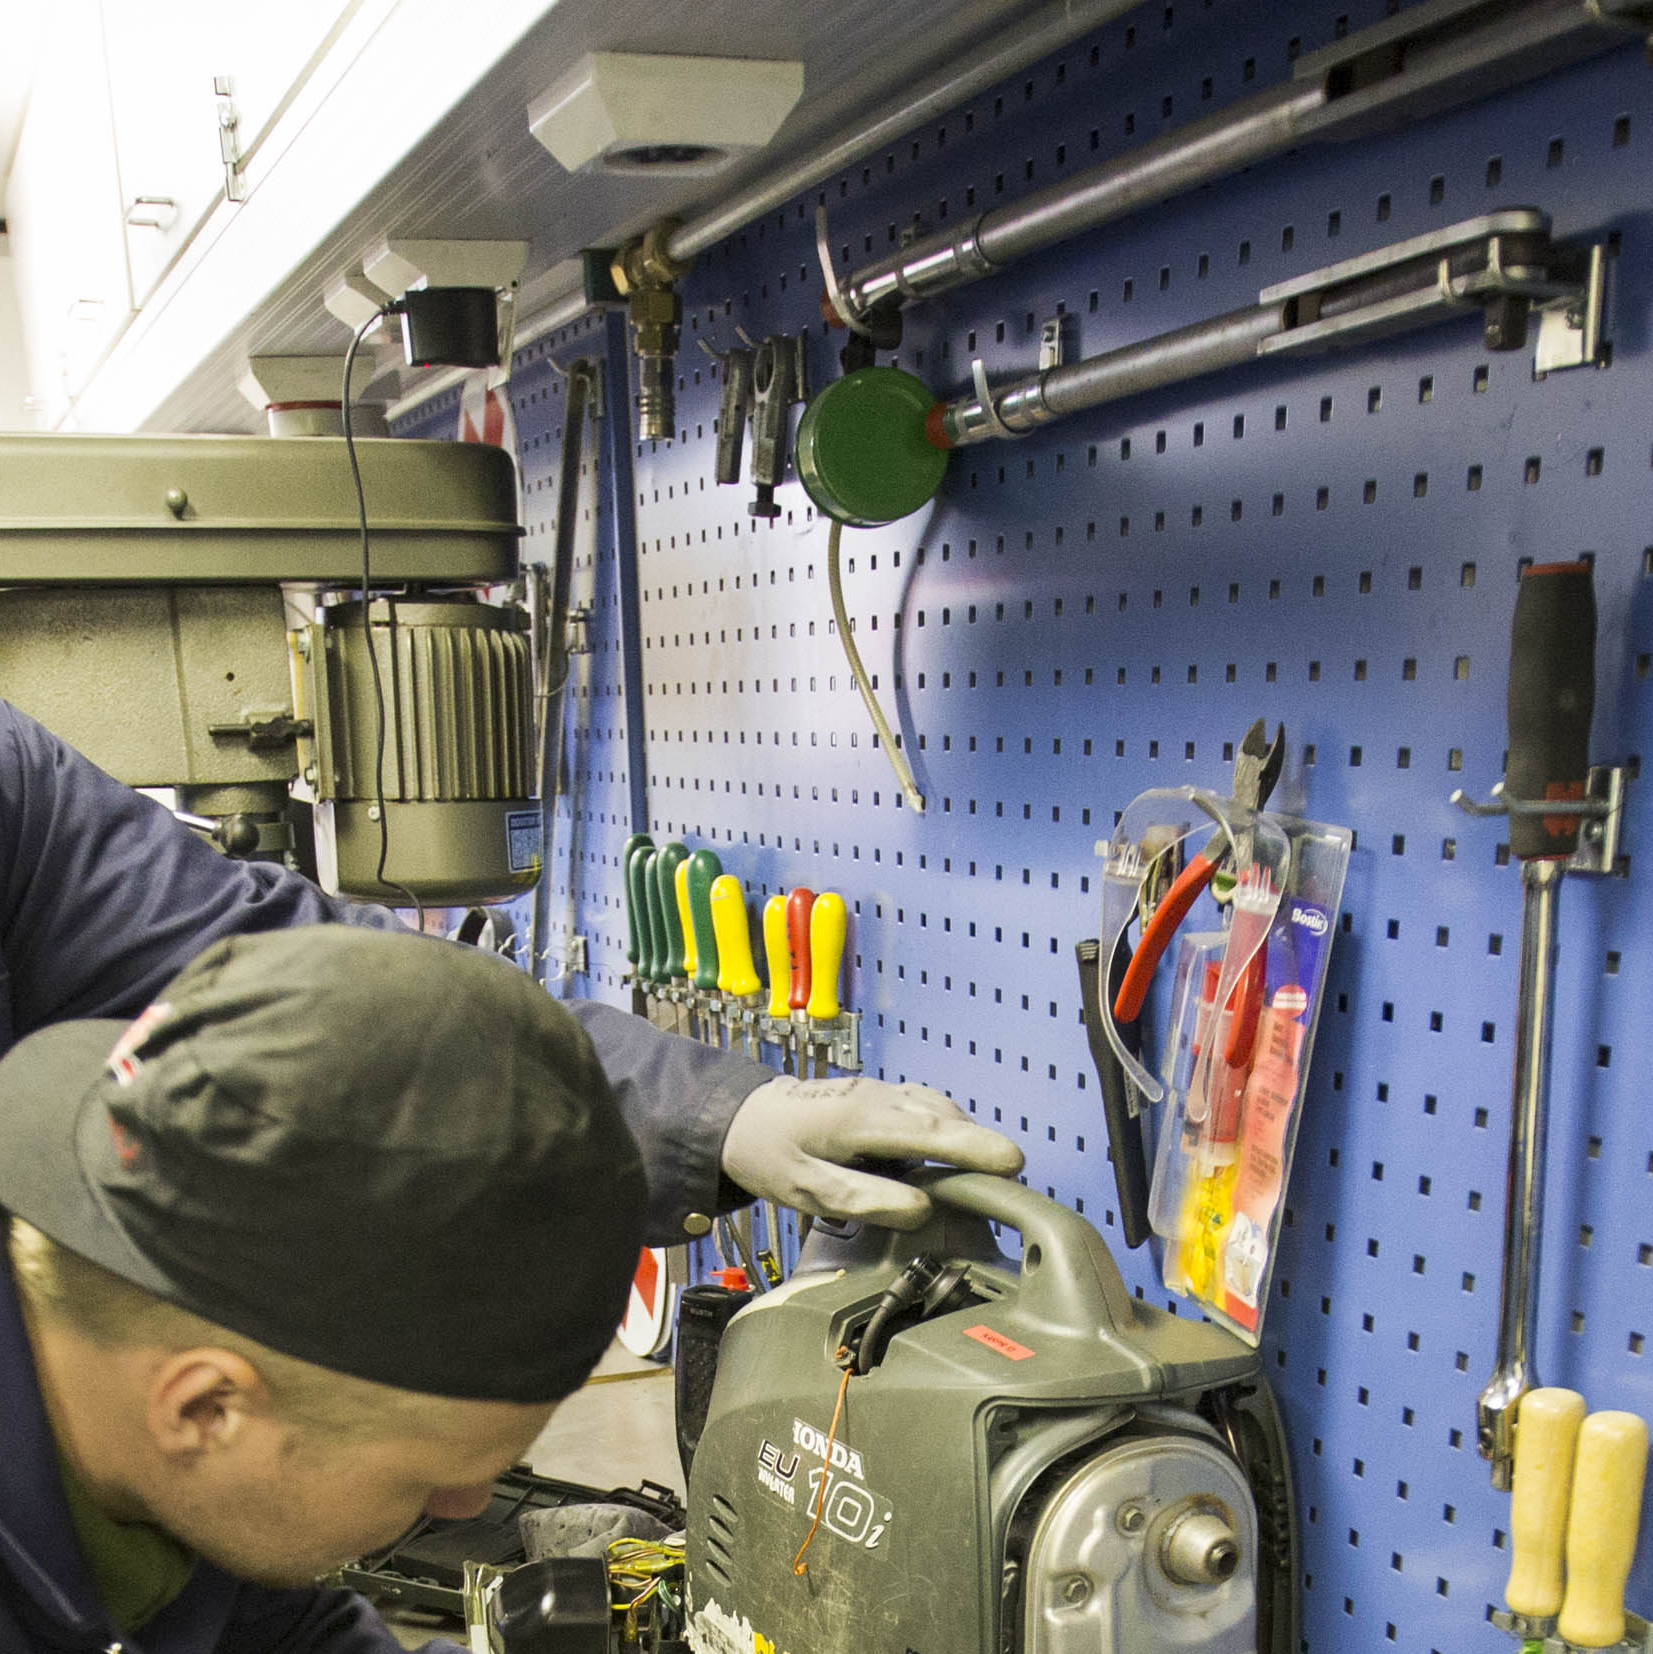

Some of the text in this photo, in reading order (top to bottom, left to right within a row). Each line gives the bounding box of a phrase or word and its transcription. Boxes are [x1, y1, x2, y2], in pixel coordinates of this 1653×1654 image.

[1291, 907, 1325, 932] Bostik
[758, 1440, 801, 1481] EU
[758, 1466, 795, 1505] INVERTER
